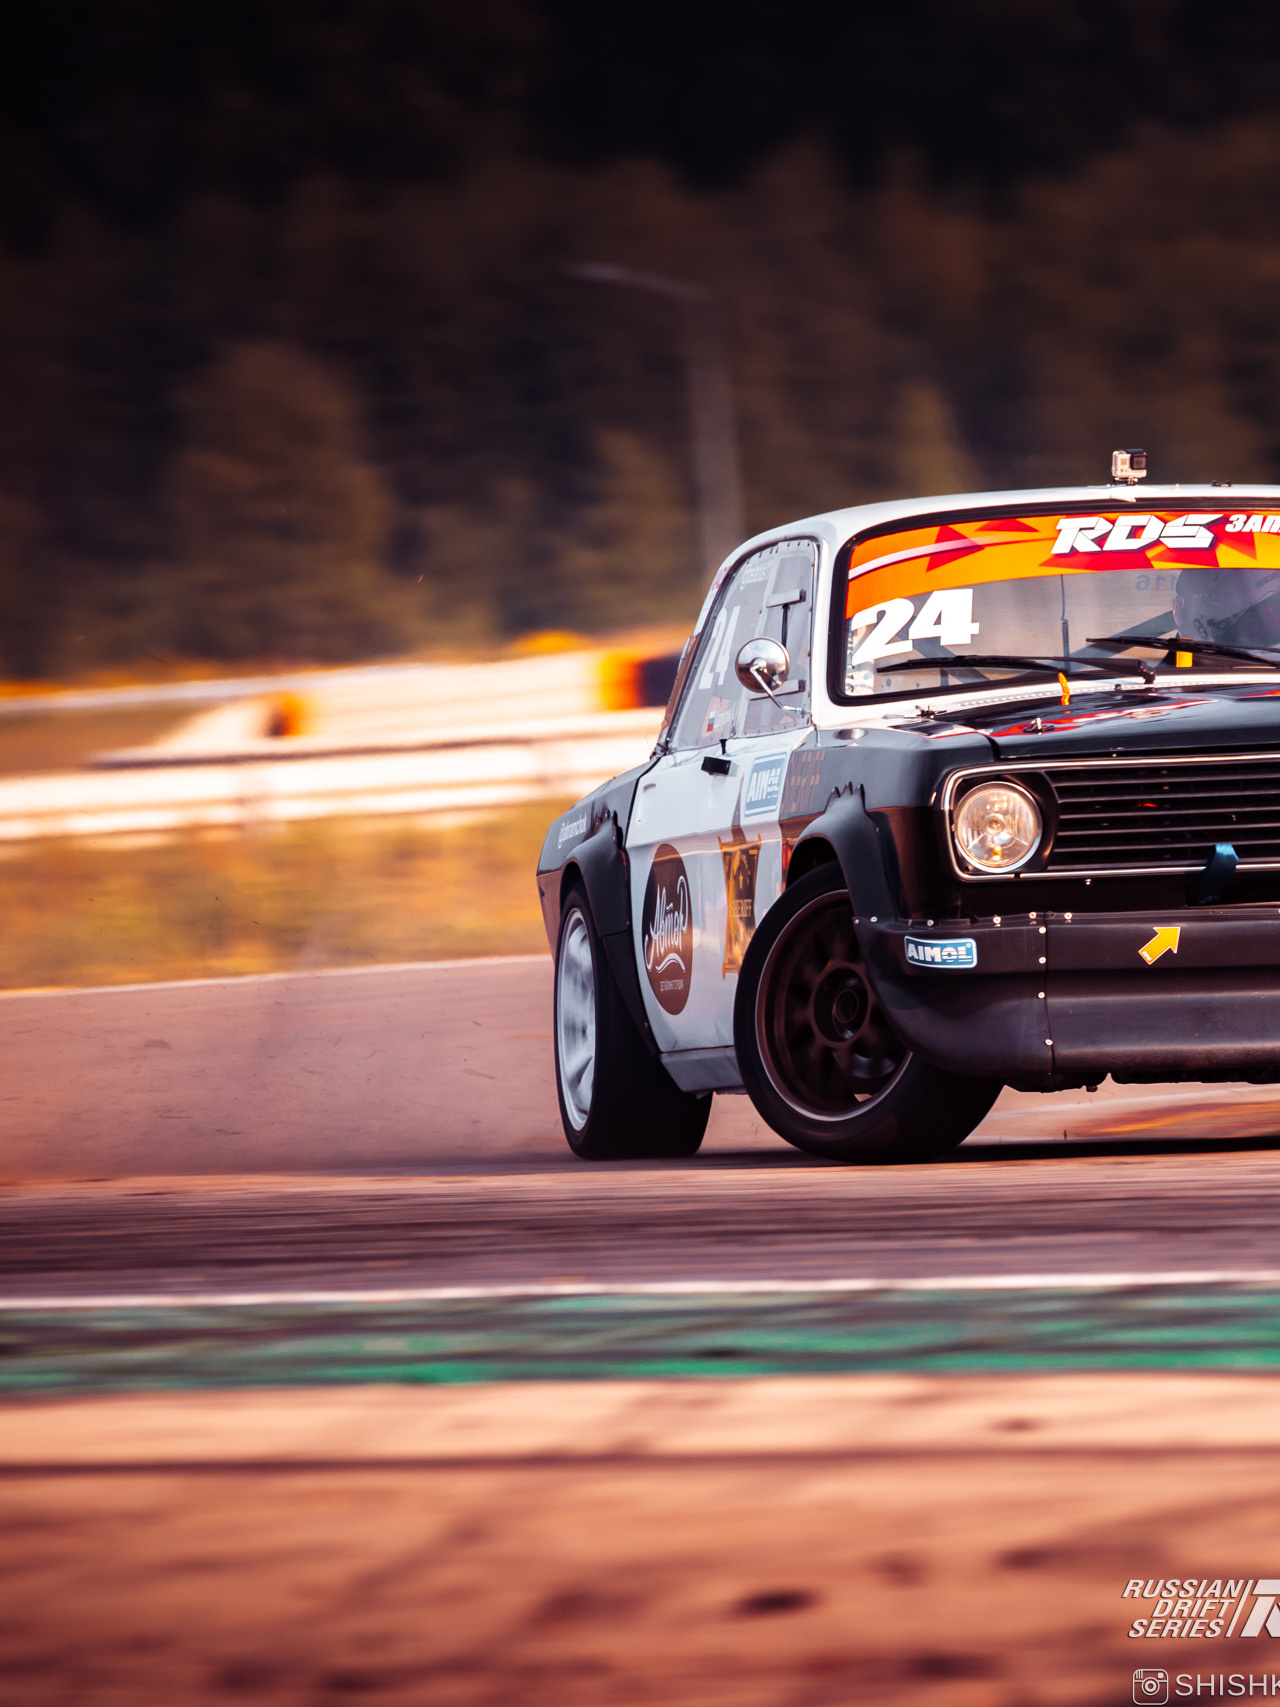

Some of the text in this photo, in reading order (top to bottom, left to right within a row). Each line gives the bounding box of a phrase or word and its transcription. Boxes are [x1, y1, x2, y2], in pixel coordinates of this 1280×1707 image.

[1051, 514, 1223, 554] RDS
[699, 605, 740, 690] 24
[852, 589, 979, 667] 24
[908, 943, 972, 962] AIMOL
